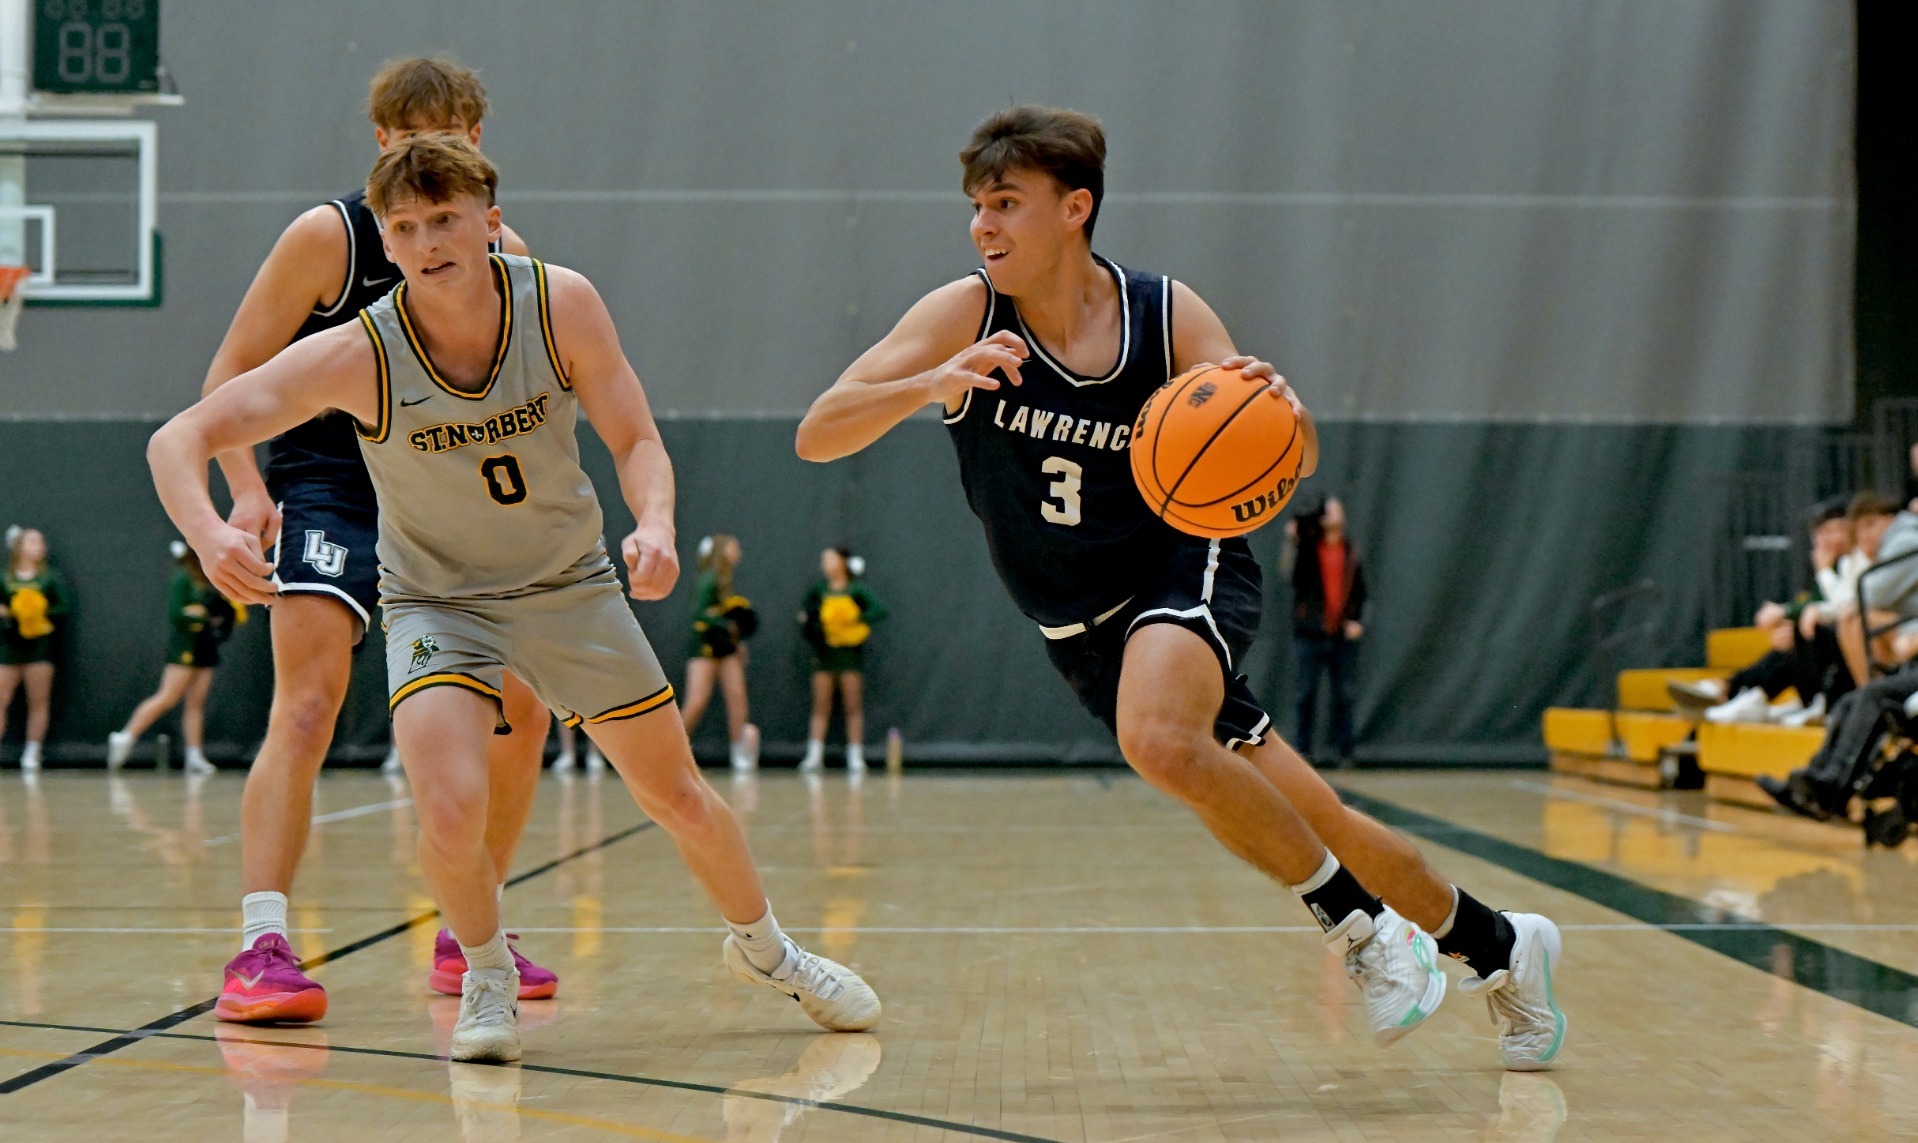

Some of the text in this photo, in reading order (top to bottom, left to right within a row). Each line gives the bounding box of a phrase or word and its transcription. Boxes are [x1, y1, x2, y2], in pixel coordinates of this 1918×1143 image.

[993, 399, 1131, 451] LAWRENC
[479, 453, 529, 506] 0
[1040, 455, 1083, 527] 3
[302, 529, 349, 578] LU
